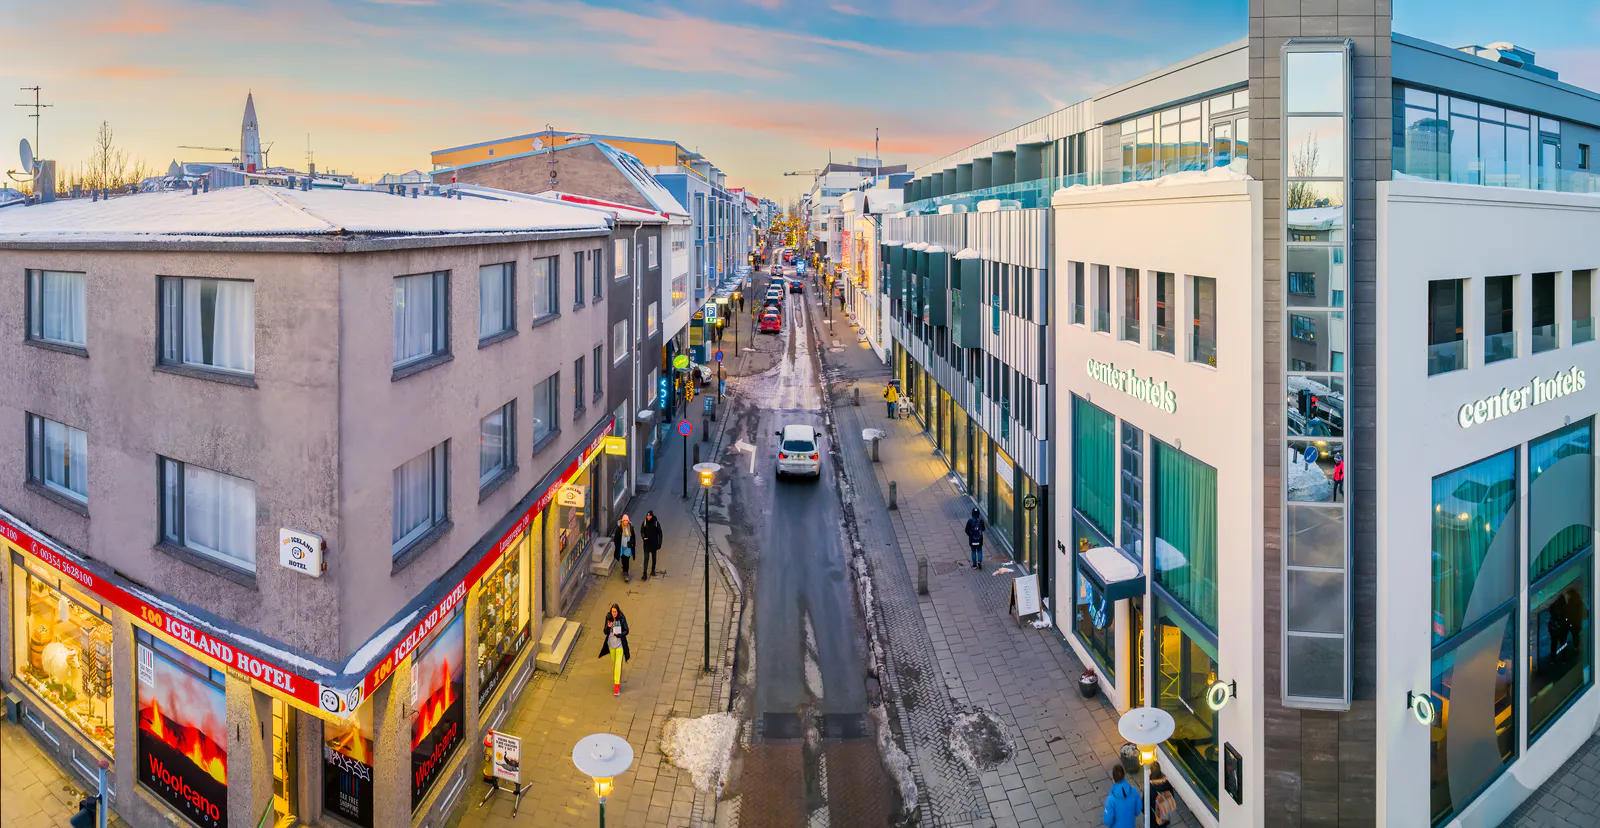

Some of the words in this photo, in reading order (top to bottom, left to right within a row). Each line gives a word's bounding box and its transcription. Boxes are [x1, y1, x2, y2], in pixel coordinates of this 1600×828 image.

[1086, 359, 1126, 393] center
[1127, 369, 1176, 414] hotels
[1458, 387, 1531, 428] center
[1531, 366, 1586, 406] hotels
[7, 527, 18, 541] 100
[41, 549, 61, 569] 00354
[62, 562, 93, 587] 5628100
[288, 560, 307, 570] HOTEL
[291, 537, 314, 553] ICELAND
[141, 606, 163, 628] 100
[165, 617, 233, 663] ICELAND
[237, 652, 295, 693] HOTEL
[374, 658, 393, 687] 100
[394, 610, 438, 665] ICELAND
[439, 581, 467, 618] HOTEL
[415, 721, 457, 788] Woolcano
[149, 753, 220, 820] Woolcano
